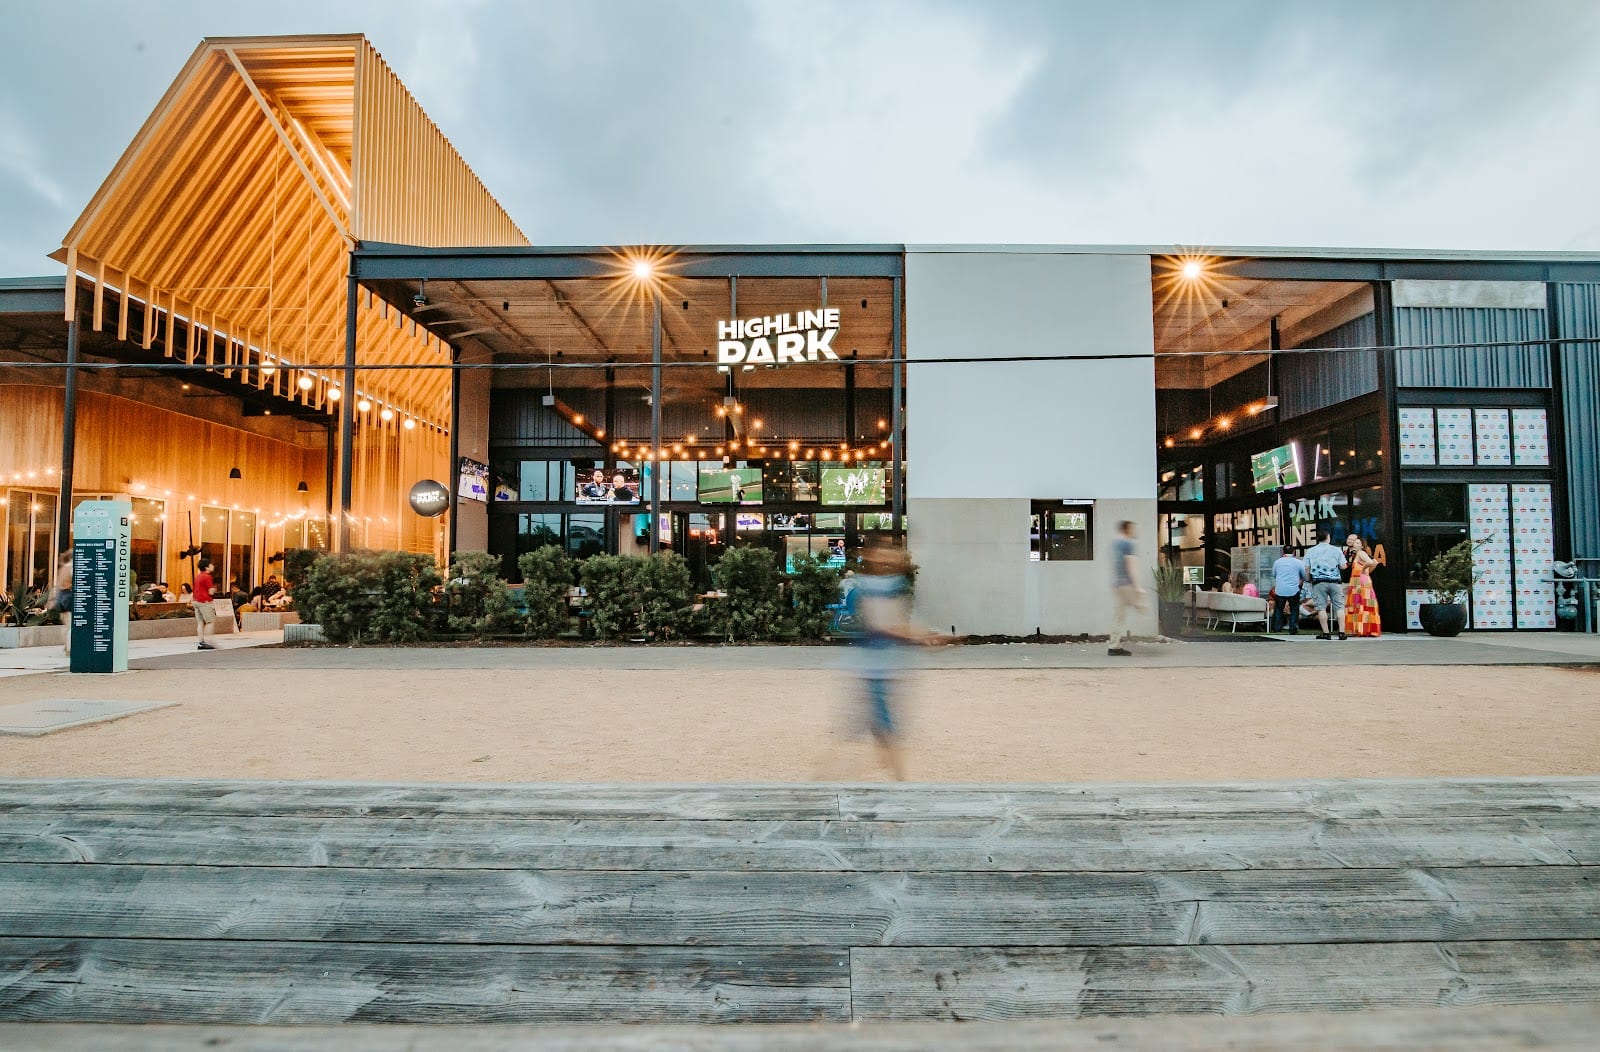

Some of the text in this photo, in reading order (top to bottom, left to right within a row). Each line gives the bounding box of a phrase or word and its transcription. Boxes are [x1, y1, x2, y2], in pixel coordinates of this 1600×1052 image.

[718, 308, 839, 340] HIGHLINE
[718, 328, 839, 373] PARK
[1237, 522, 1317, 548] HIGHNE
[118, 533, 128, 598] DIRECTORY
